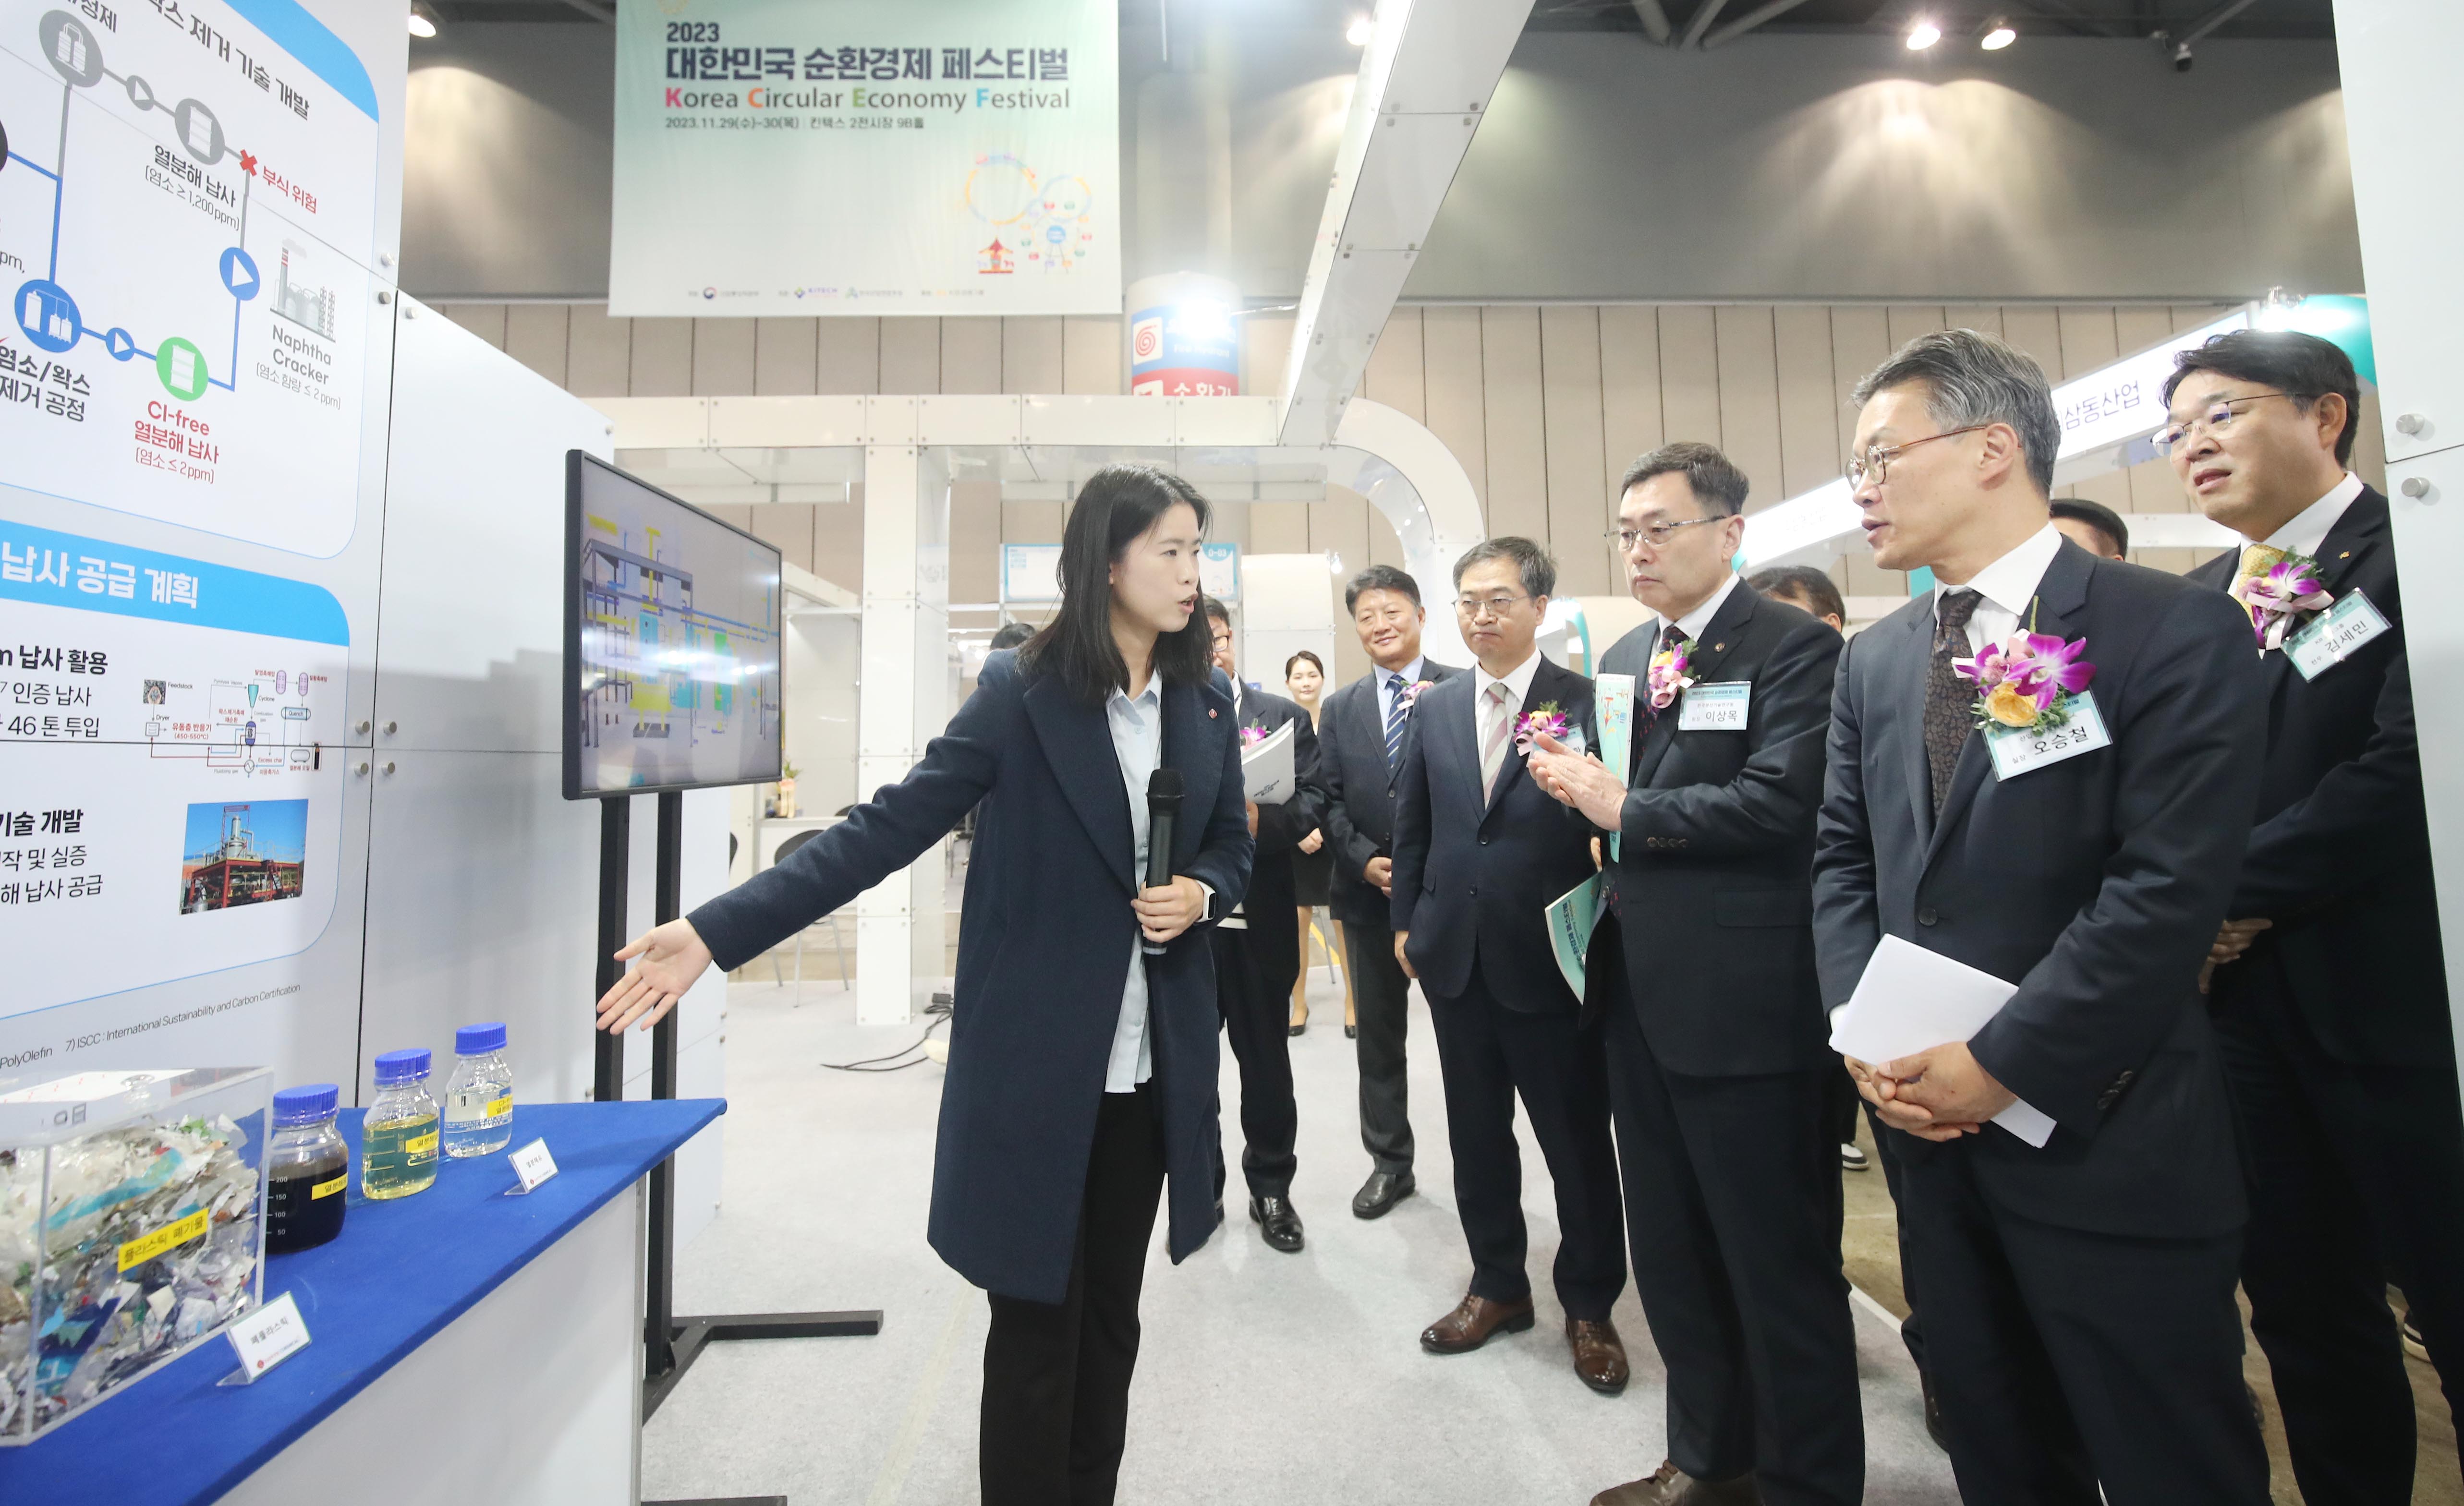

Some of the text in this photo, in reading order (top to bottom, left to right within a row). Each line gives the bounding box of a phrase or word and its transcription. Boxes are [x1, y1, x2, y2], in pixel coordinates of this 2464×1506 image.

[666, 22, 720, 43] 2023
[190, 14, 230, 63] 제거
[236, 48, 270, 93] 기술
[276, 78, 309, 120] 개발
[666, 47, 1068, 81] 대한민국 순환경제 페스티벌
[665, 87, 1070, 113] Korea Circular Economy Festival
[810, 117, 844, 129] 킨텍스
[155, 145, 236, 208] 열분해 납사
[262, 165, 317, 215] 부식 위험
[272, 324, 331, 366] Naphtha
[0, 345, 90, 397] 염소/왁스
[273, 348, 329, 385] Cracker
[0, 375, 85, 422] 제거 공정
[282, 373, 301, 393] 함량
[314, 388, 319, 400] 2
[320, 393, 341, 410] ppm)
[134, 420, 219, 465] 열분해 납사
[180, 461, 187, 475] 2
[188, 465, 214, 484] ppm)
[1, 541, 199, 610] 납사 공급 계획
[2324, 620, 2369, 653] 김세민
[19, 645, 63, 672] 납사
[67, 649, 109, 675] 활용
[13, 682, 51, 705] 인증
[56, 685, 92, 707] 납사
[168, 682, 193, 690] Feedstock
[8, 715, 100, 738] 46 톤 투입
[1705, 710, 1737, 722] 이상목
[2034, 725, 2089, 756] 오승철
[0, 808, 84, 837] 기술 개발
[0, 845, 87, 872] 작 및 실증
[25, 878, 64, 903] 납사
[68, 874, 103, 898] 공급
[0, 1046, 53, 1070] PolyOlefin
[65, 1038, 75, 1053] 7)
[77, 1033, 101, 1049] ISCC
[107, 1017, 161, 1041] International
[162, 1005, 216, 1027] Sustainability
[217, 1000, 231, 1012] and
[231, 995, 259, 1009] Carbon
[259, 983, 301, 1001] Certification
[124, 1216, 204, 1264] 플라스틱 폐기물
